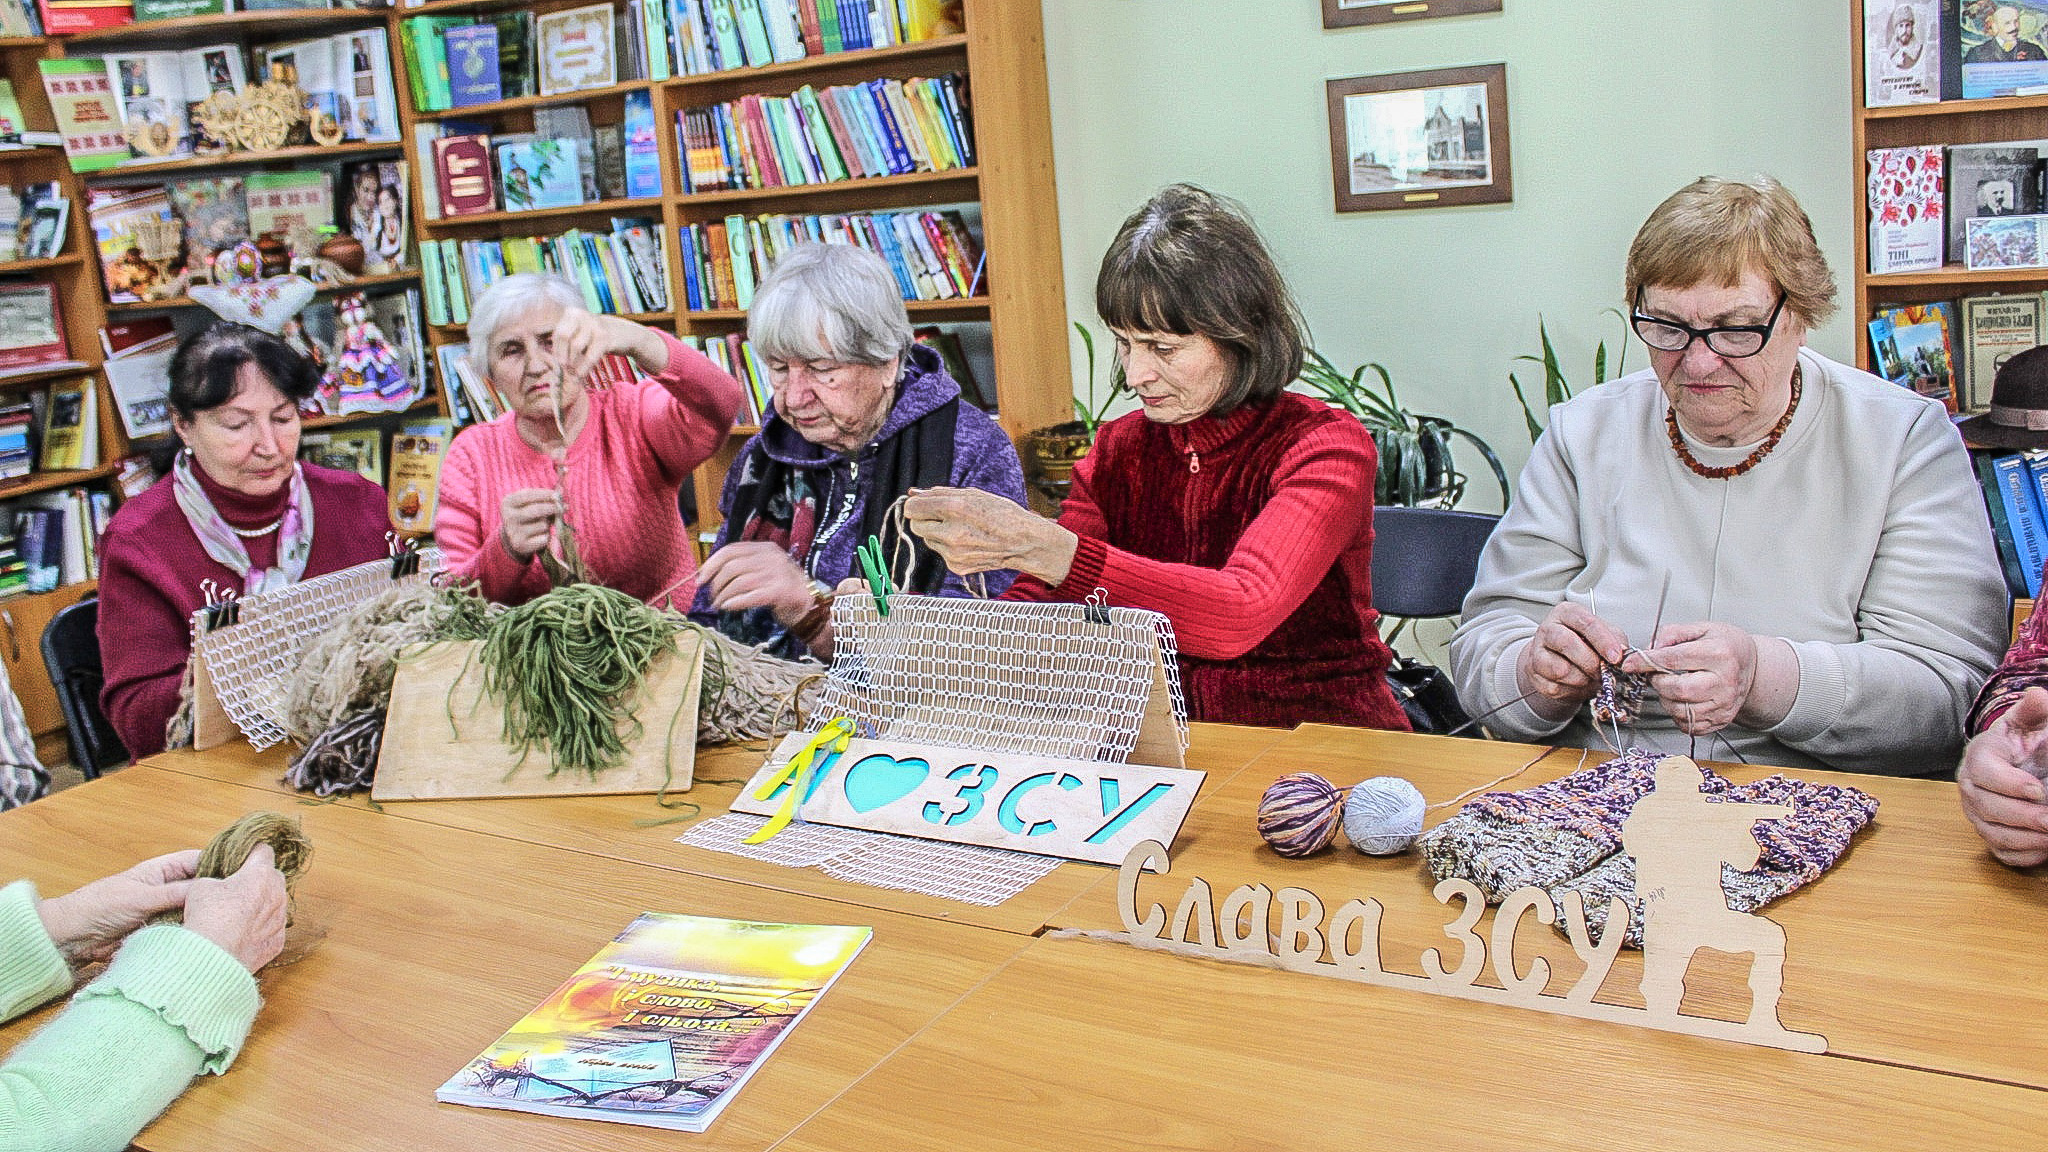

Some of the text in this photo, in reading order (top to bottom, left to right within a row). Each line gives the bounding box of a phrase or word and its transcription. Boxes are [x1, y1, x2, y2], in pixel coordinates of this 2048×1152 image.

[815, 494, 856, 544] FASHION
[921, 763, 1176, 844] ЗСУ
[1117, 839, 1631, 1004] Слава ЗСУ
[627, 971, 721, 993] музика,
[640, 993, 717, 1012] слово,
